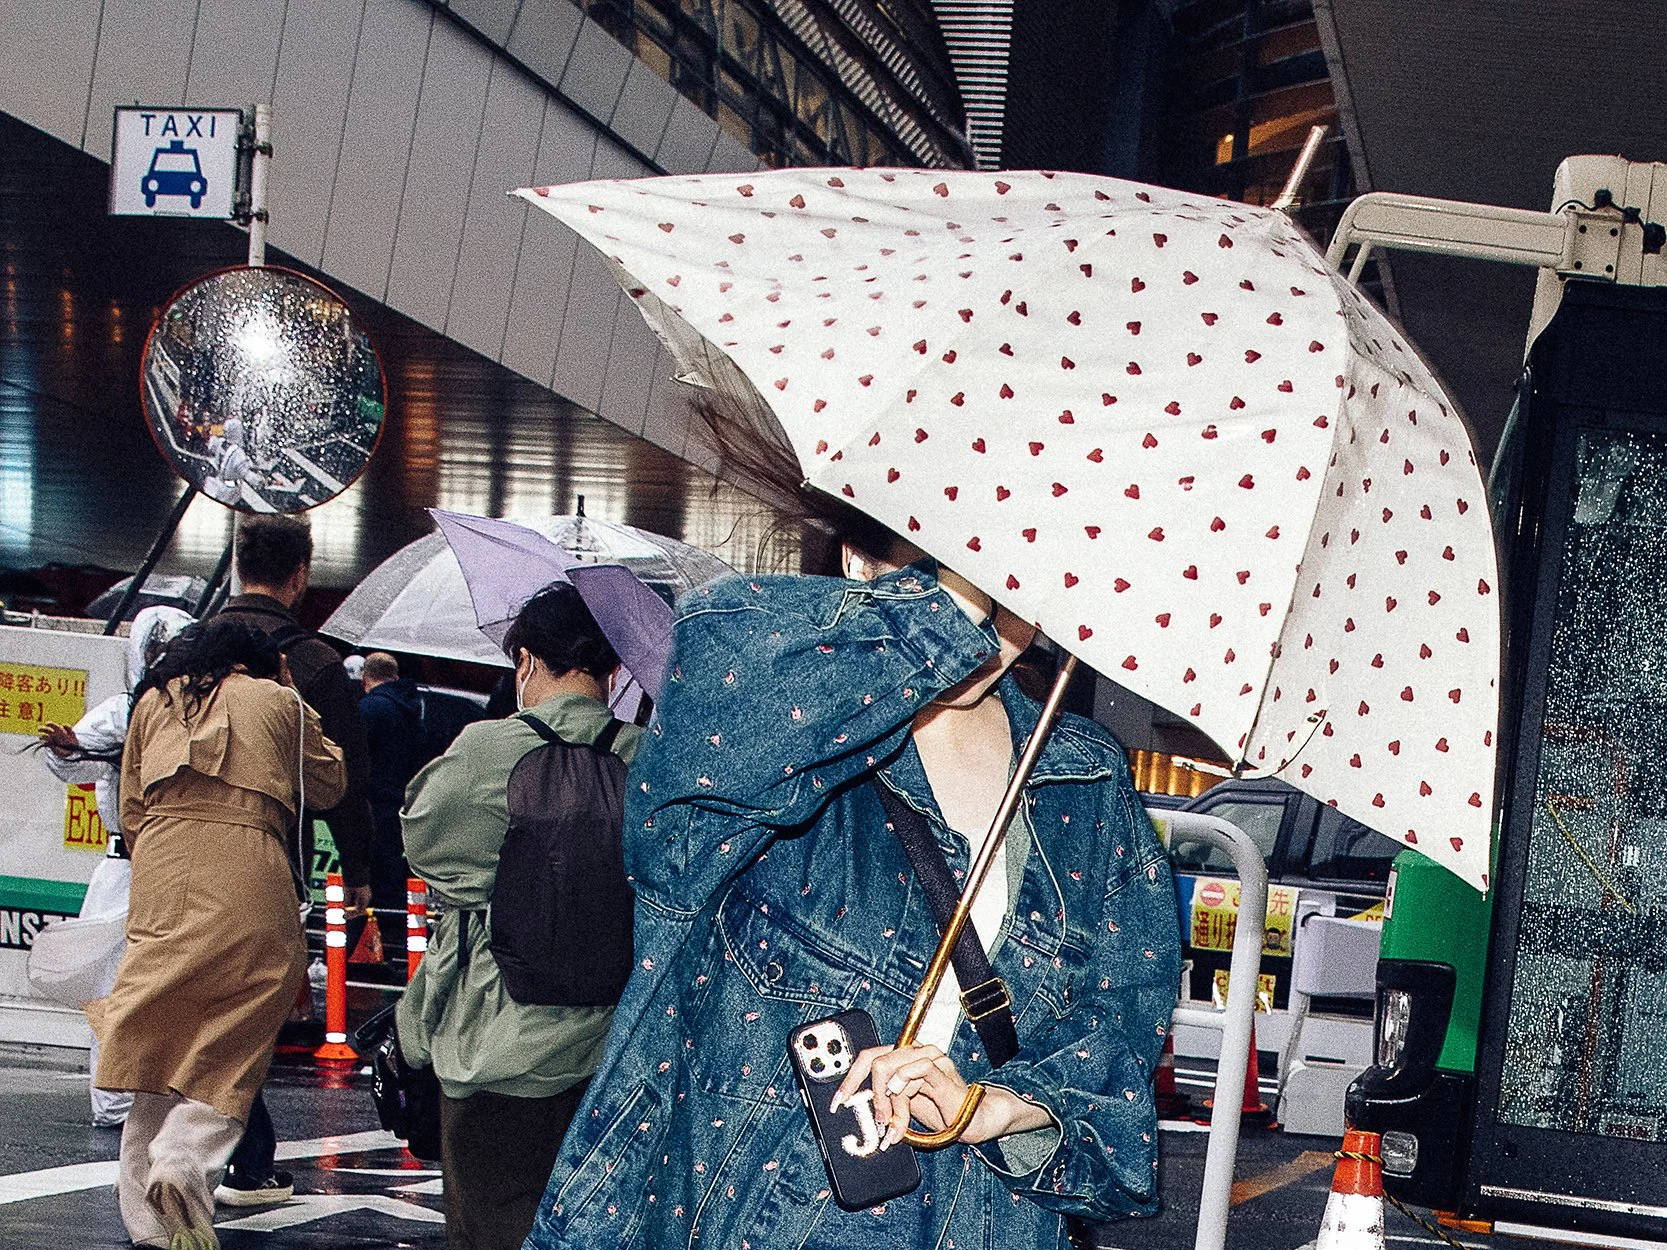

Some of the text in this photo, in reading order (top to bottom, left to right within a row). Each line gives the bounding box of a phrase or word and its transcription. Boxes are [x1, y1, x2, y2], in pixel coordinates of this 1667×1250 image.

[140, 113, 216, 139] TAXI
[66, 794, 109, 845] En
[841, 1089, 880, 1159] J
